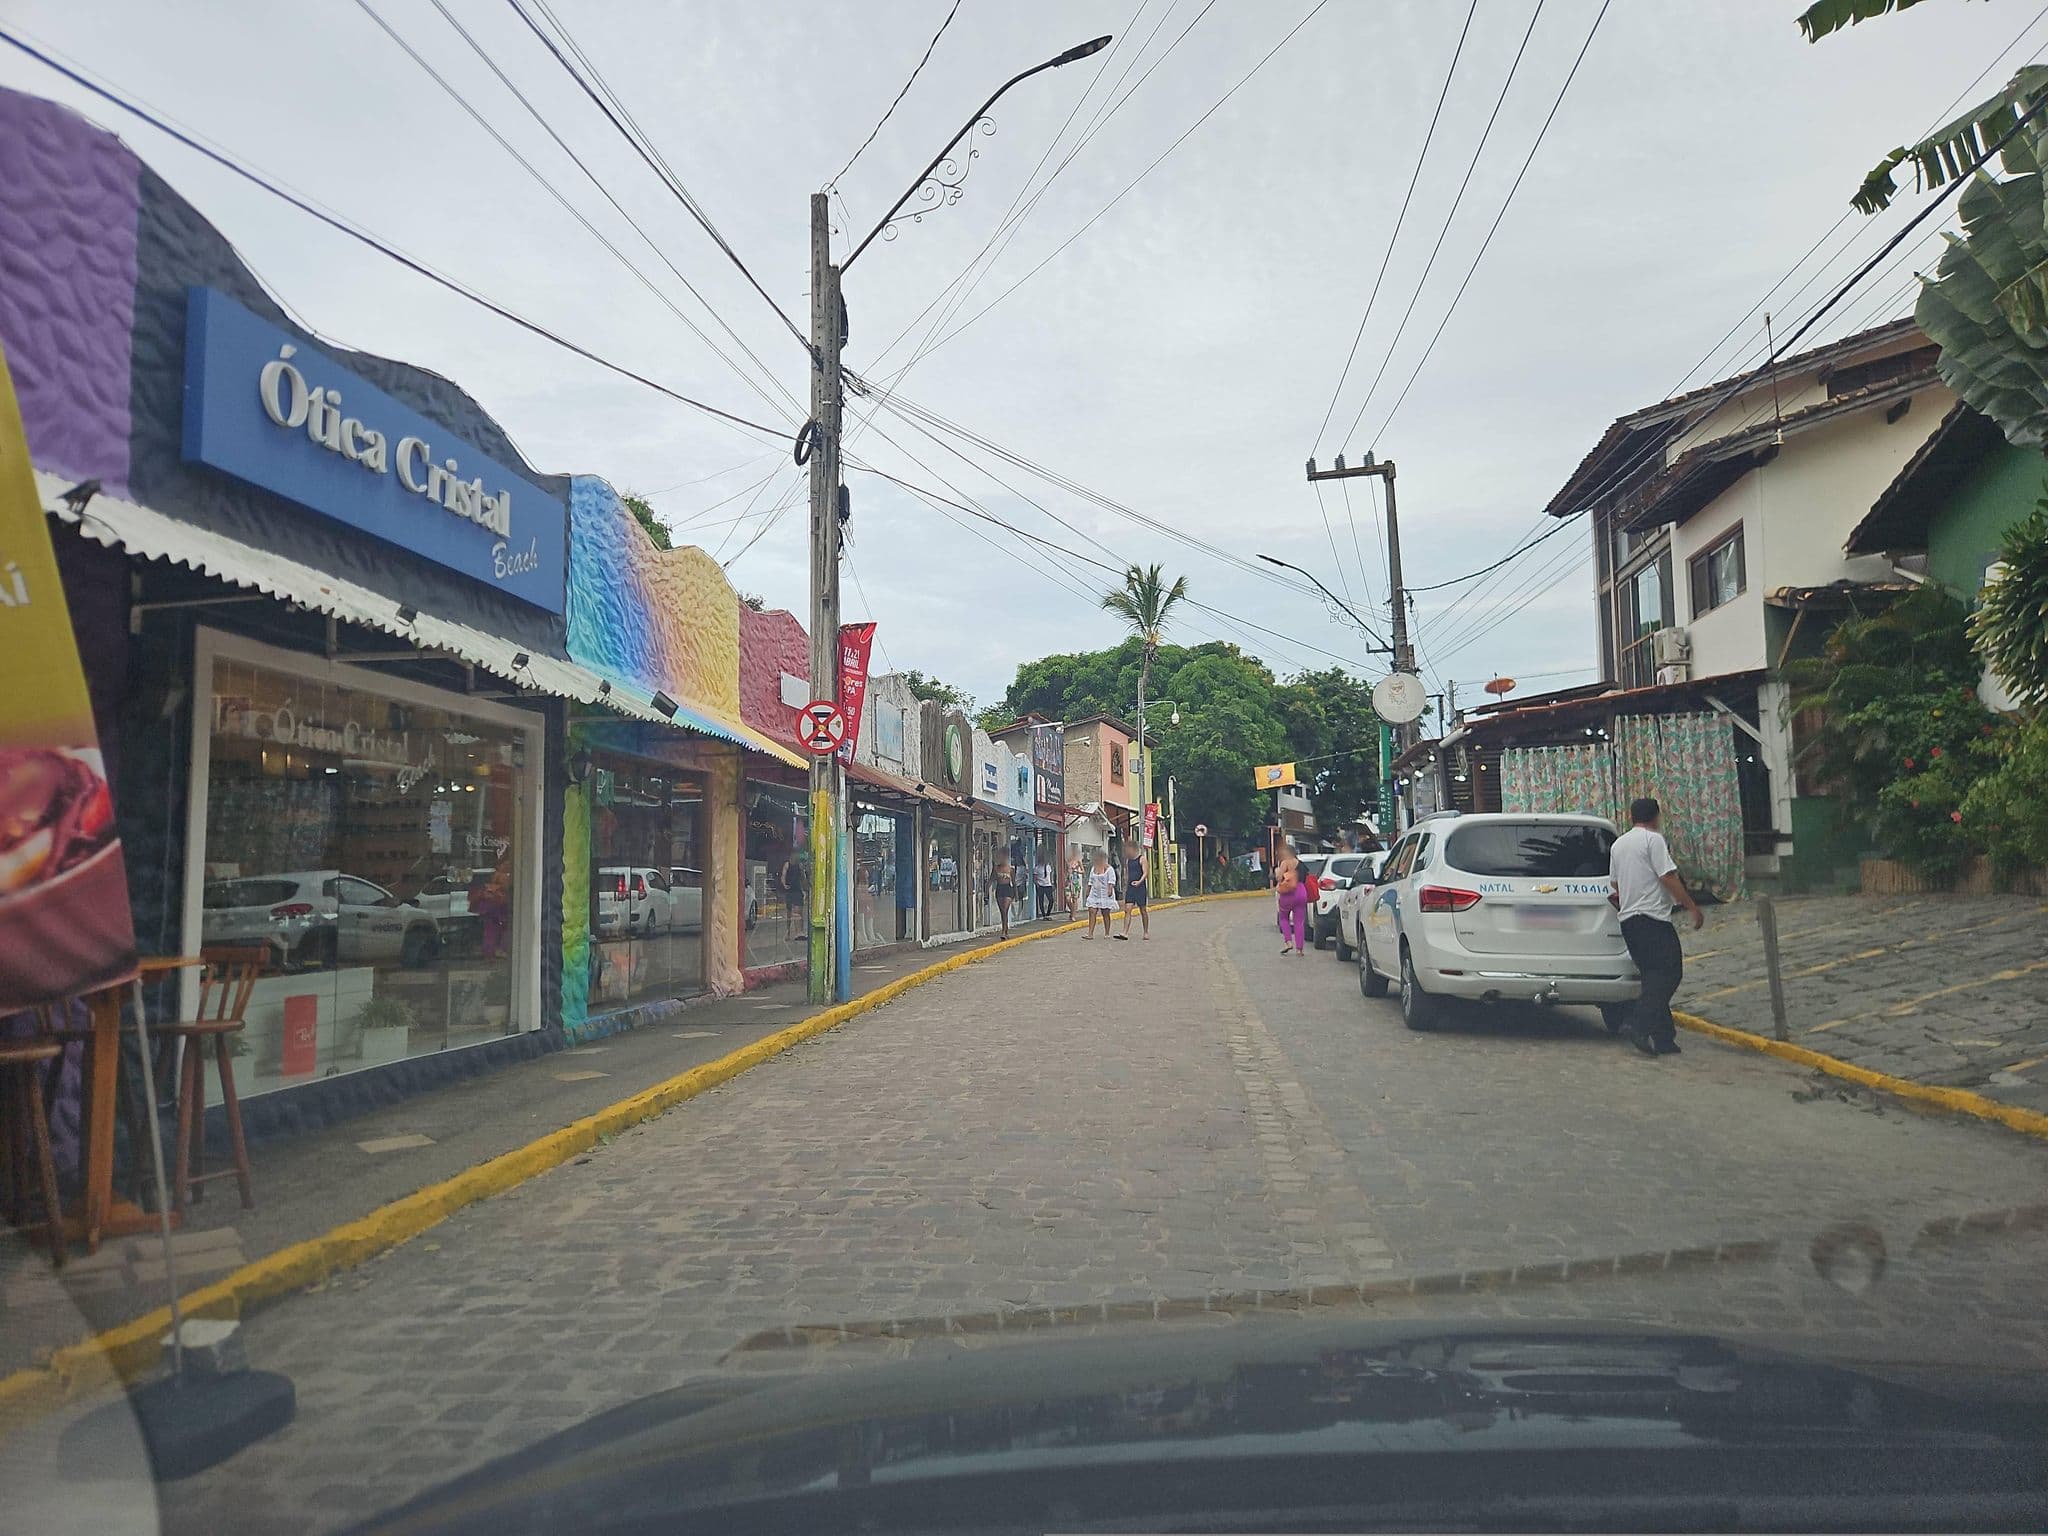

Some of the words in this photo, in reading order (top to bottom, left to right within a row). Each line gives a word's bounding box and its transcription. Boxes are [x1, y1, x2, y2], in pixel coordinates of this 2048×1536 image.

[260, 344, 388, 474] Ótica
[396, 437, 511, 538] Cristal
[491, 537, 539, 580] Beach
[1479, 883, 1515, 893] NATAL
